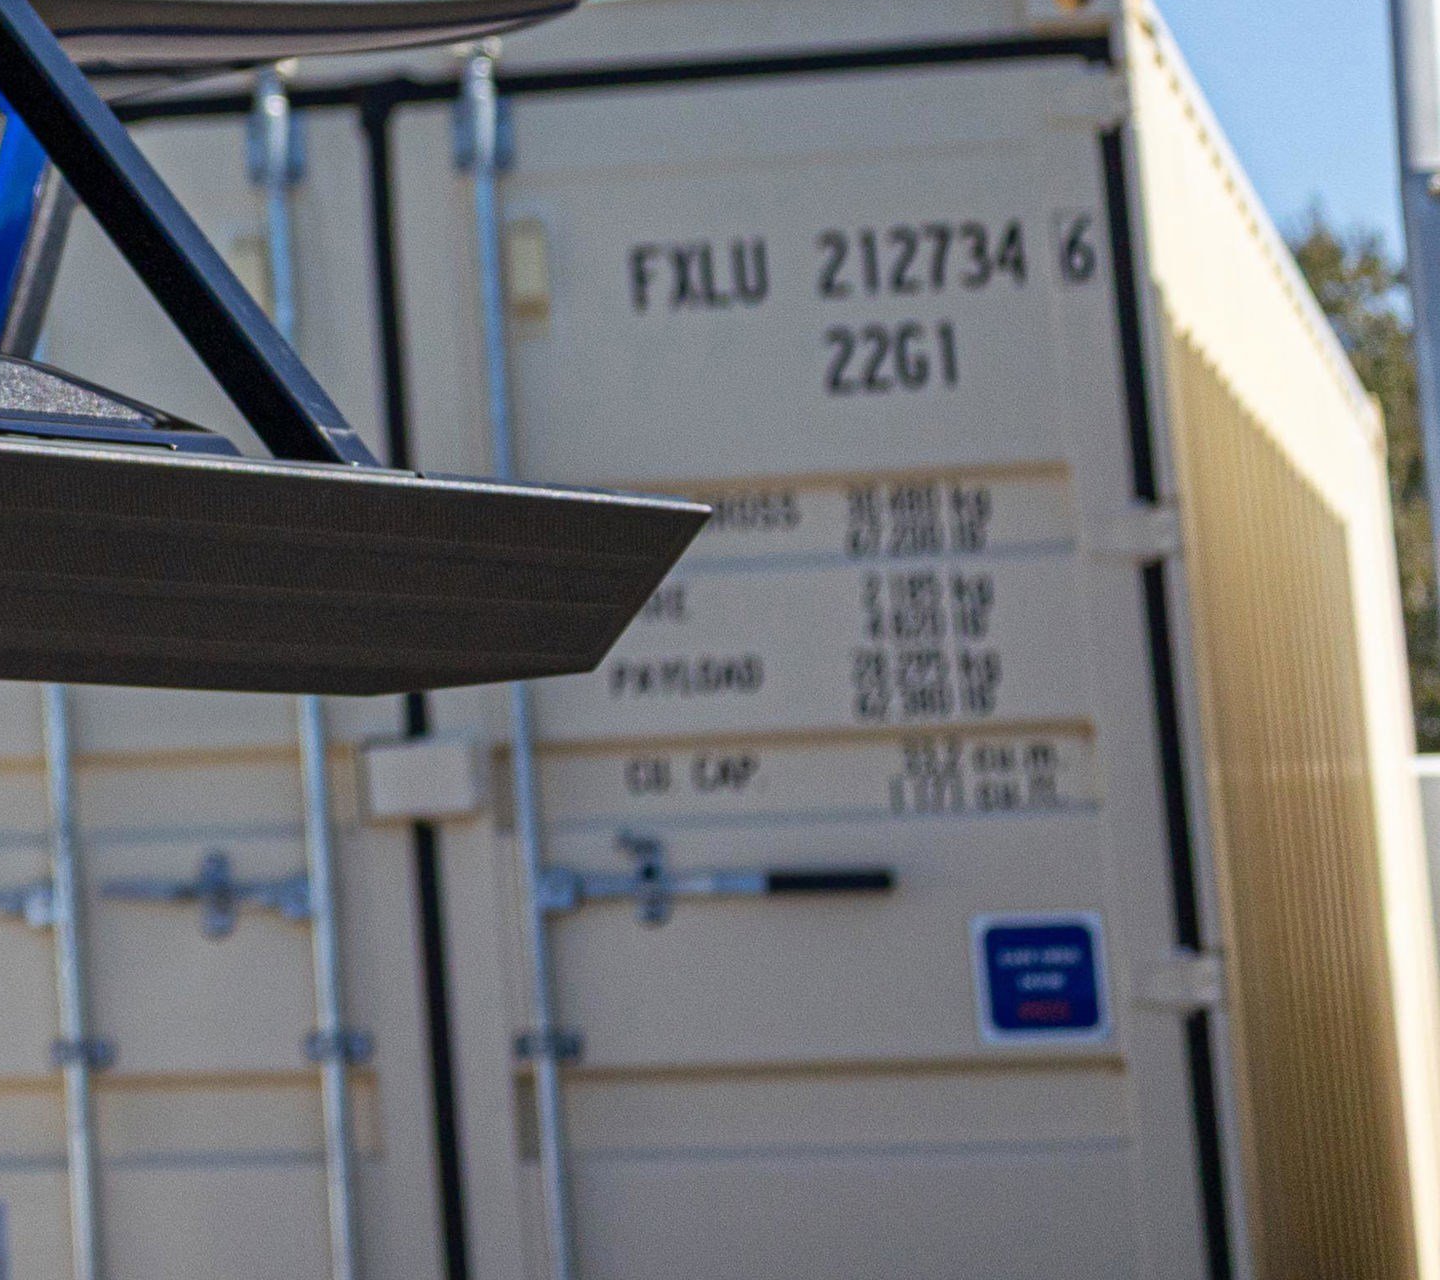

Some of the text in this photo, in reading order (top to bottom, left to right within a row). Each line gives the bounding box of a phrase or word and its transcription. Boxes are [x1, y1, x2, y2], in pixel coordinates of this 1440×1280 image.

[628, 214, 1096, 313] FXLU 212734 6
[823, 319, 960, 395] 22G1
